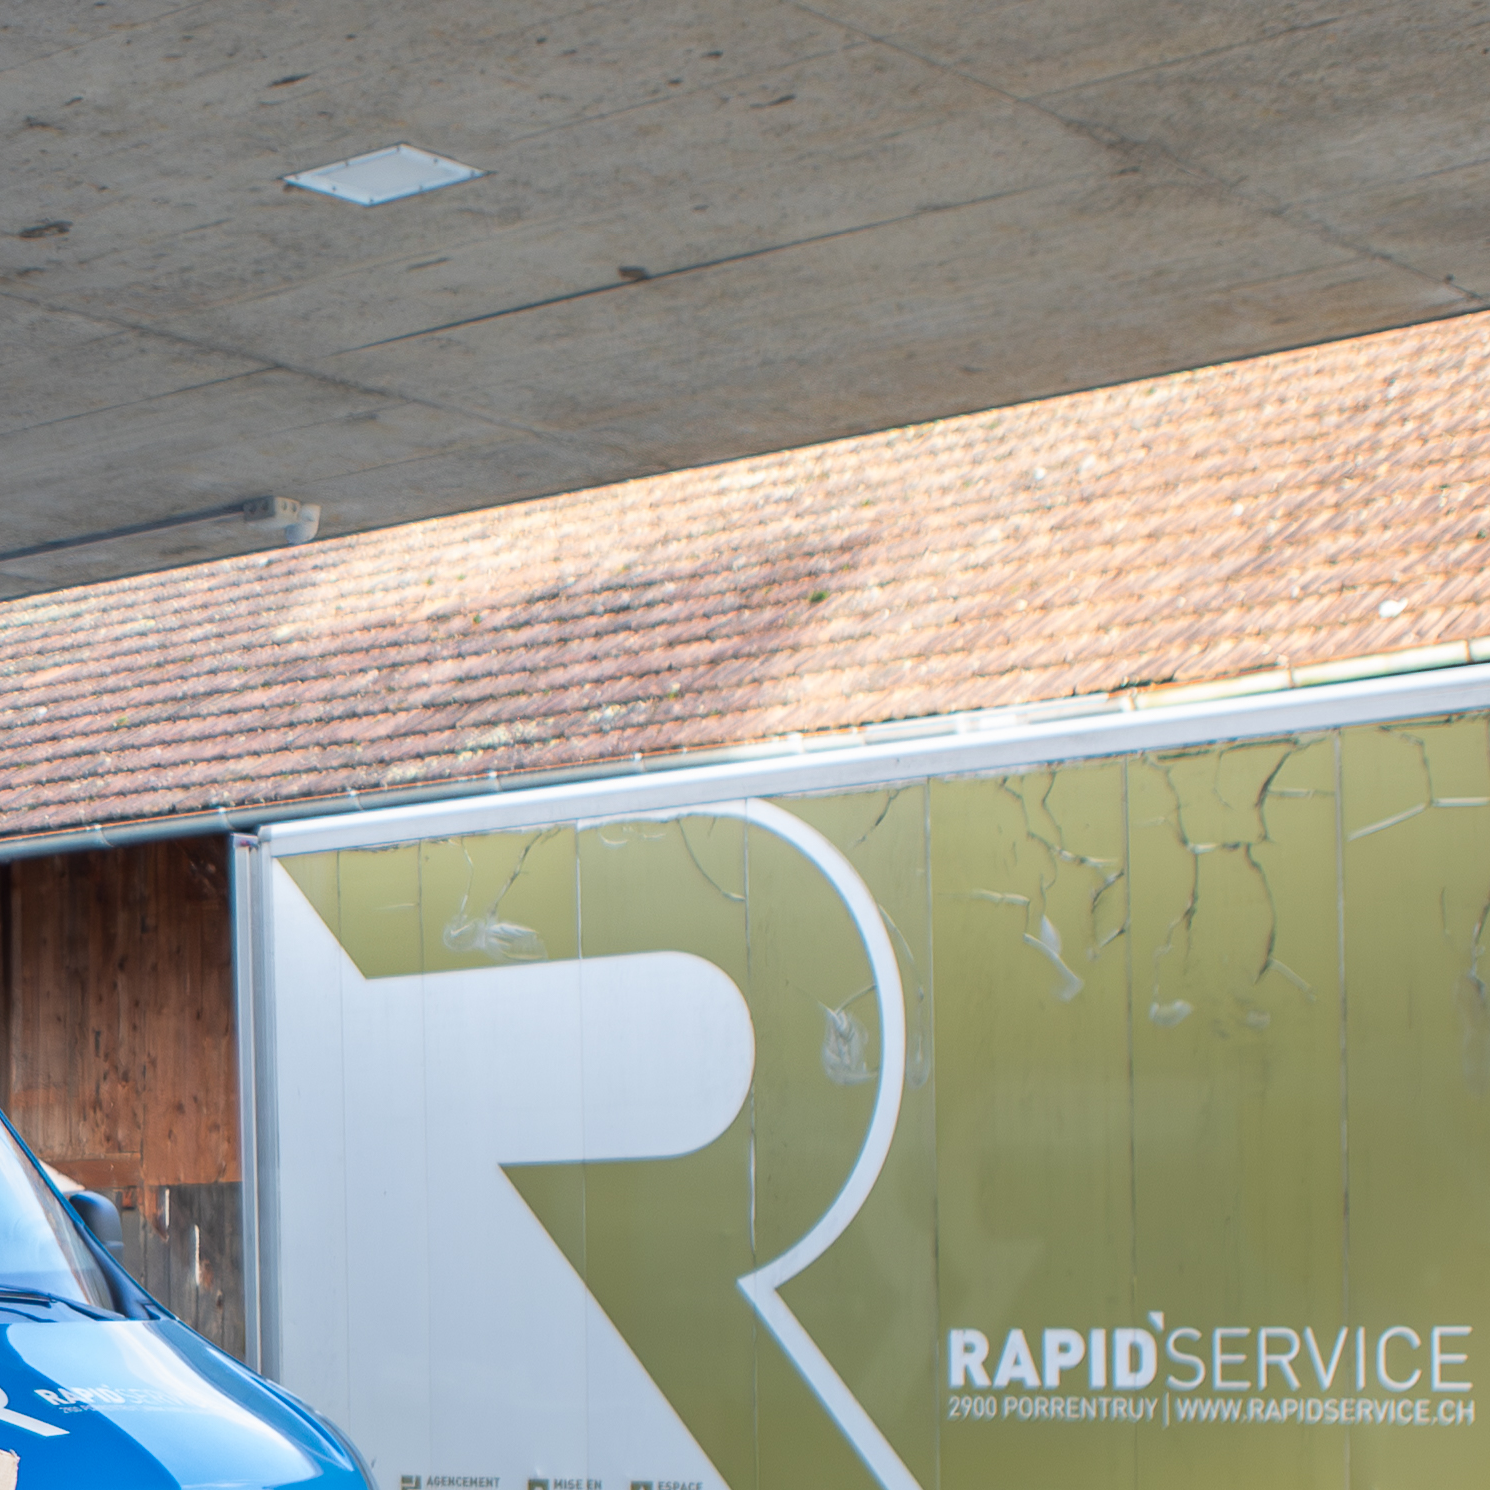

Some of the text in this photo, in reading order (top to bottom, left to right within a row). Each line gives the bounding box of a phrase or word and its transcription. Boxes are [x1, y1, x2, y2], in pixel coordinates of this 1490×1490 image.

[948, 1396, 1476, 1426] 2900 PORRENTRUY WWW.RAPIDSERVICE.CH
[426, 1475, 501, 1489] AGENCEMENT
[553, 1478, 603, 1490] MISE EN
